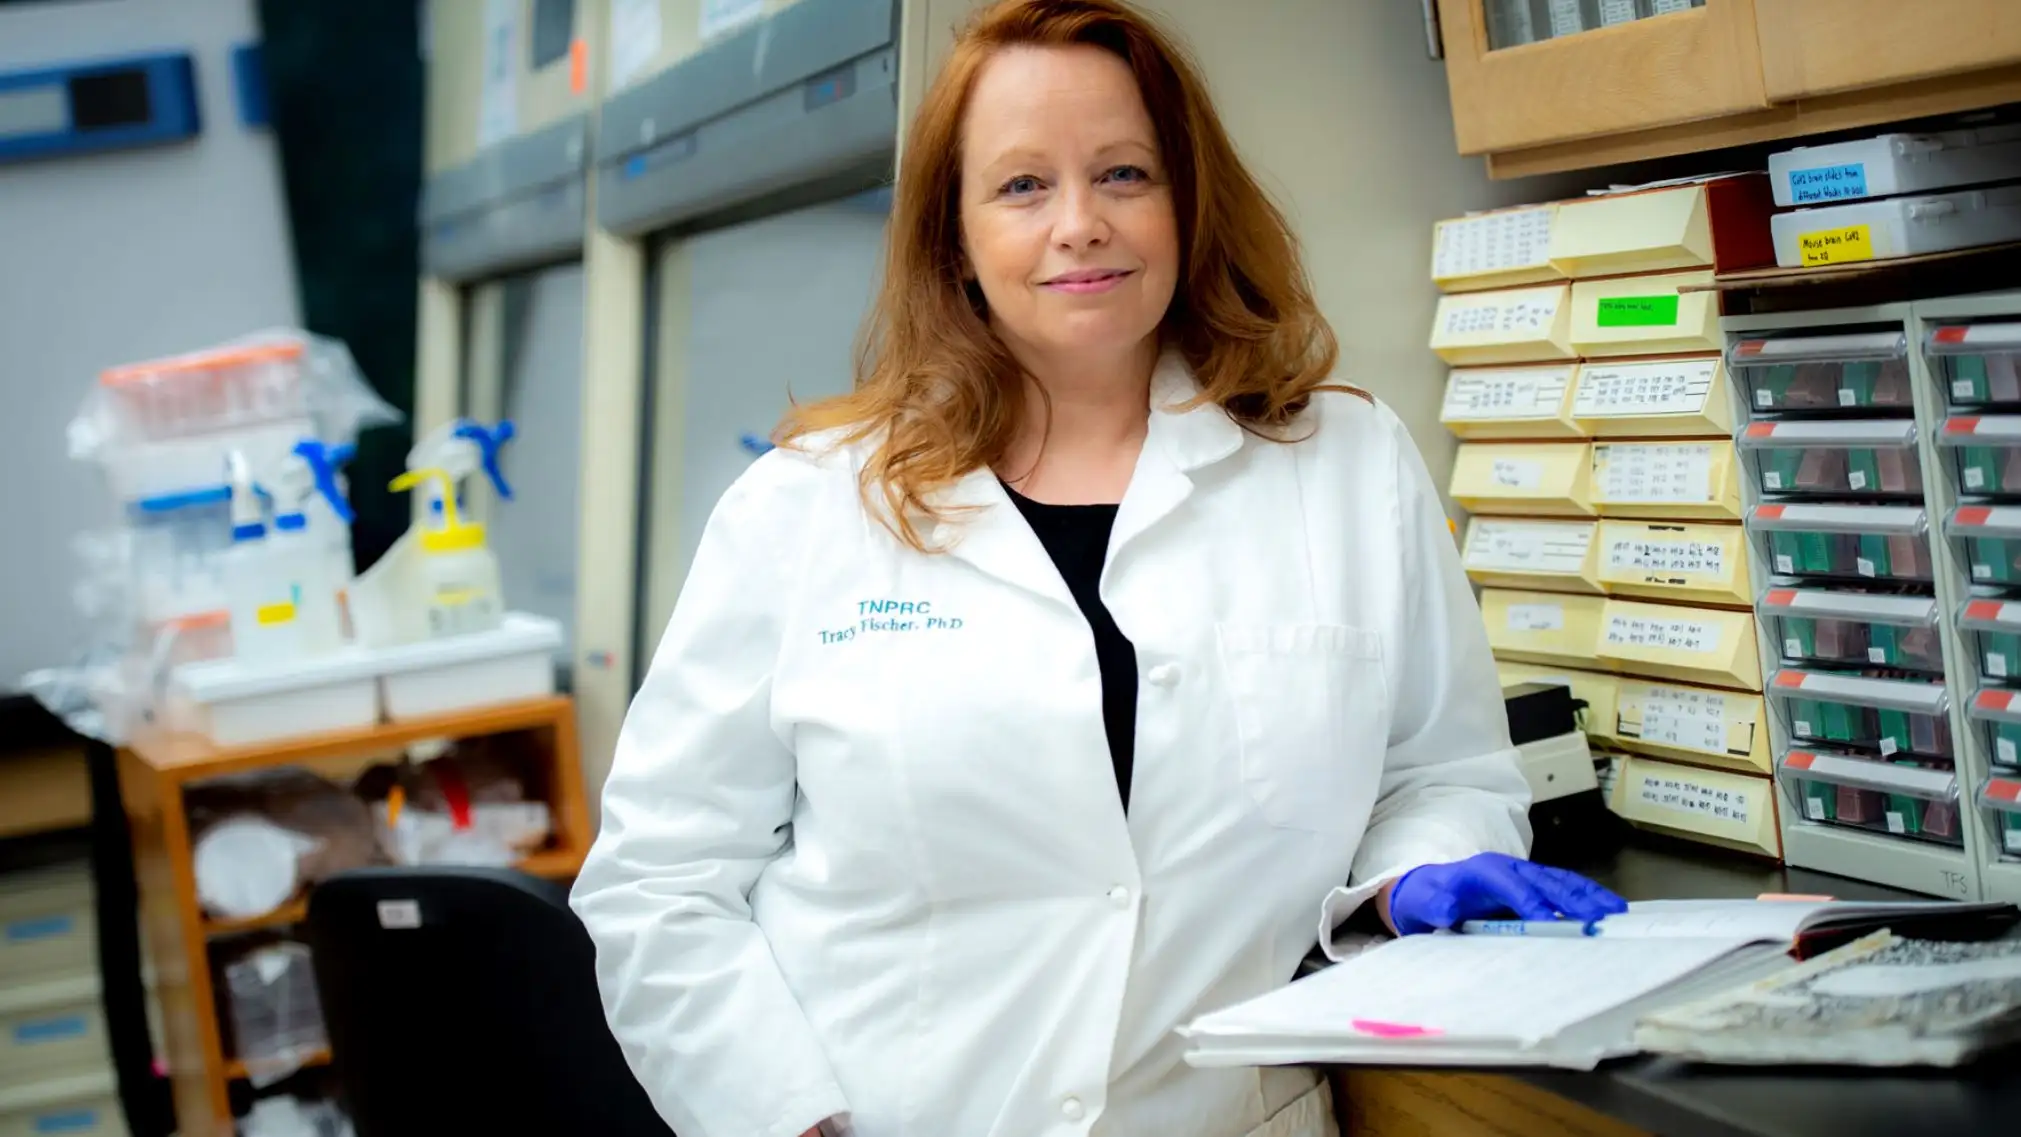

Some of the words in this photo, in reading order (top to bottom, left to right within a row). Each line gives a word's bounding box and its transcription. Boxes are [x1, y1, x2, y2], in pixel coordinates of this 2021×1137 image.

[1803, 239, 1823, 249] Mouse
[1824, 235, 1842, 245] brain
[858, 600, 931, 615] TNPRC
[819, 626, 856, 645] Tracy
[927, 617, 963, 630] PhD
[1939, 870, 1968, 894] TFS
